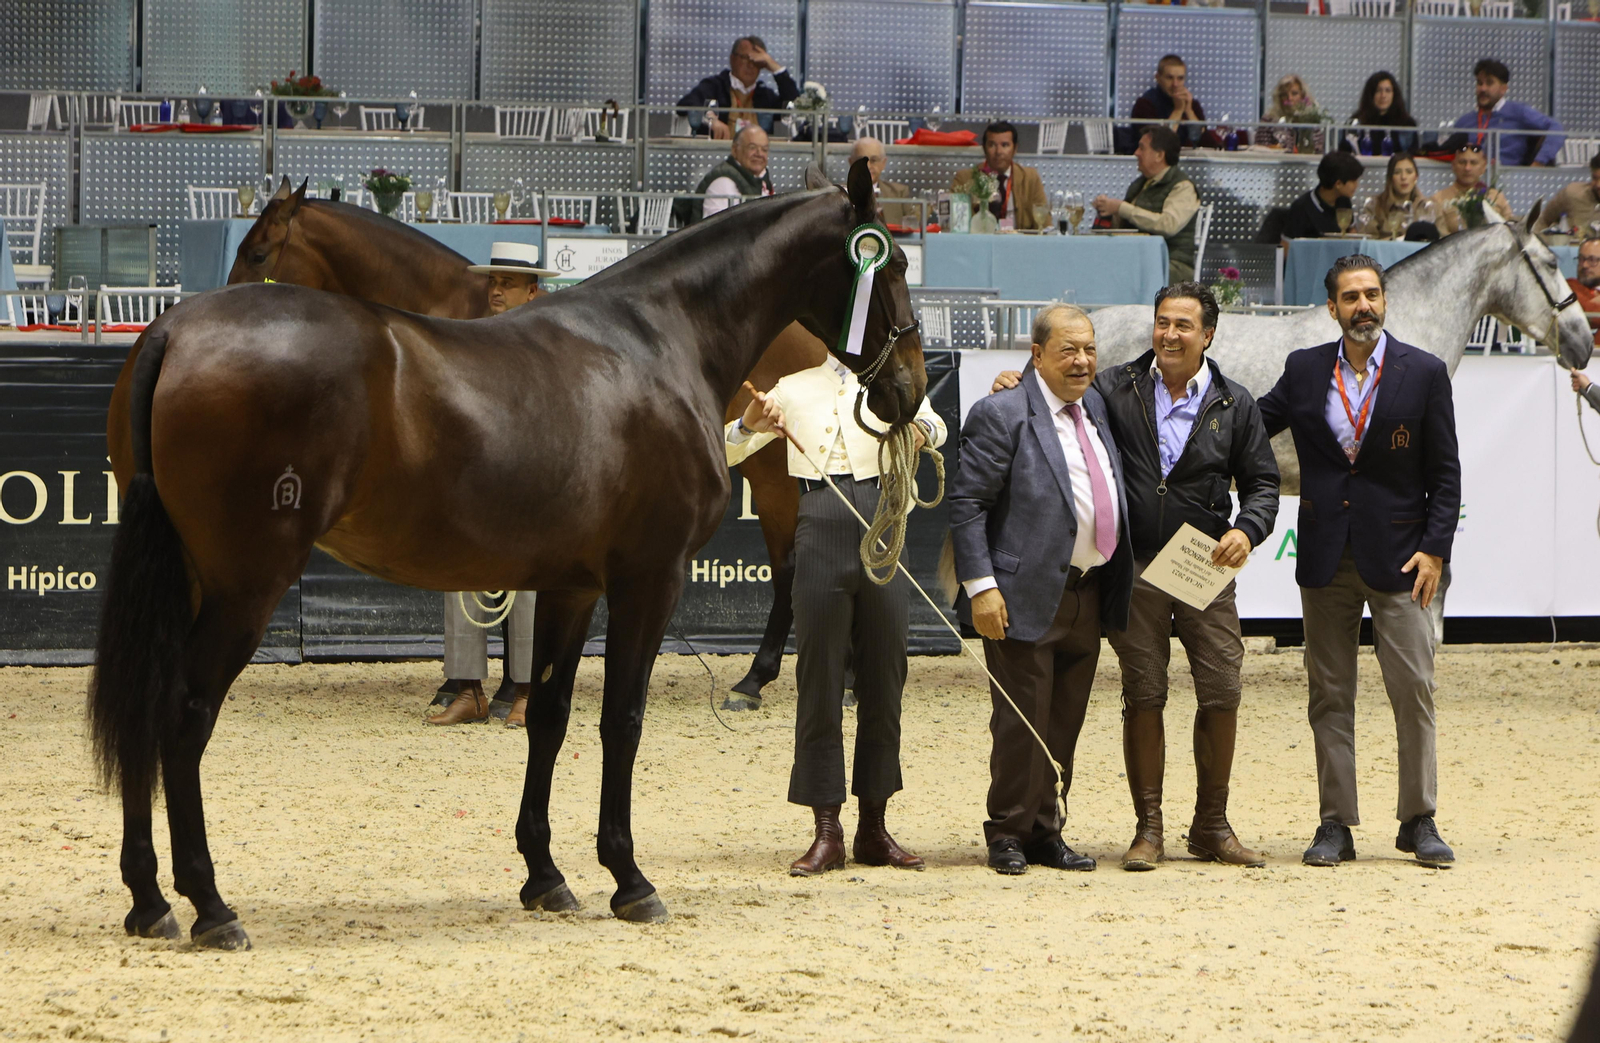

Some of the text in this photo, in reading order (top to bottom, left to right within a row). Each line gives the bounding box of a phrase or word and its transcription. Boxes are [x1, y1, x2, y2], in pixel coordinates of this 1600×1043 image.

[1179, 544, 1206, 563] MENCIÓN
[1190, 536, 1210, 552] QUINTA
[8, 565, 97, 596] Hípico
[691, 559, 773, 588] Hípico
[1171, 568, 1204, 588] SICAB 2023
